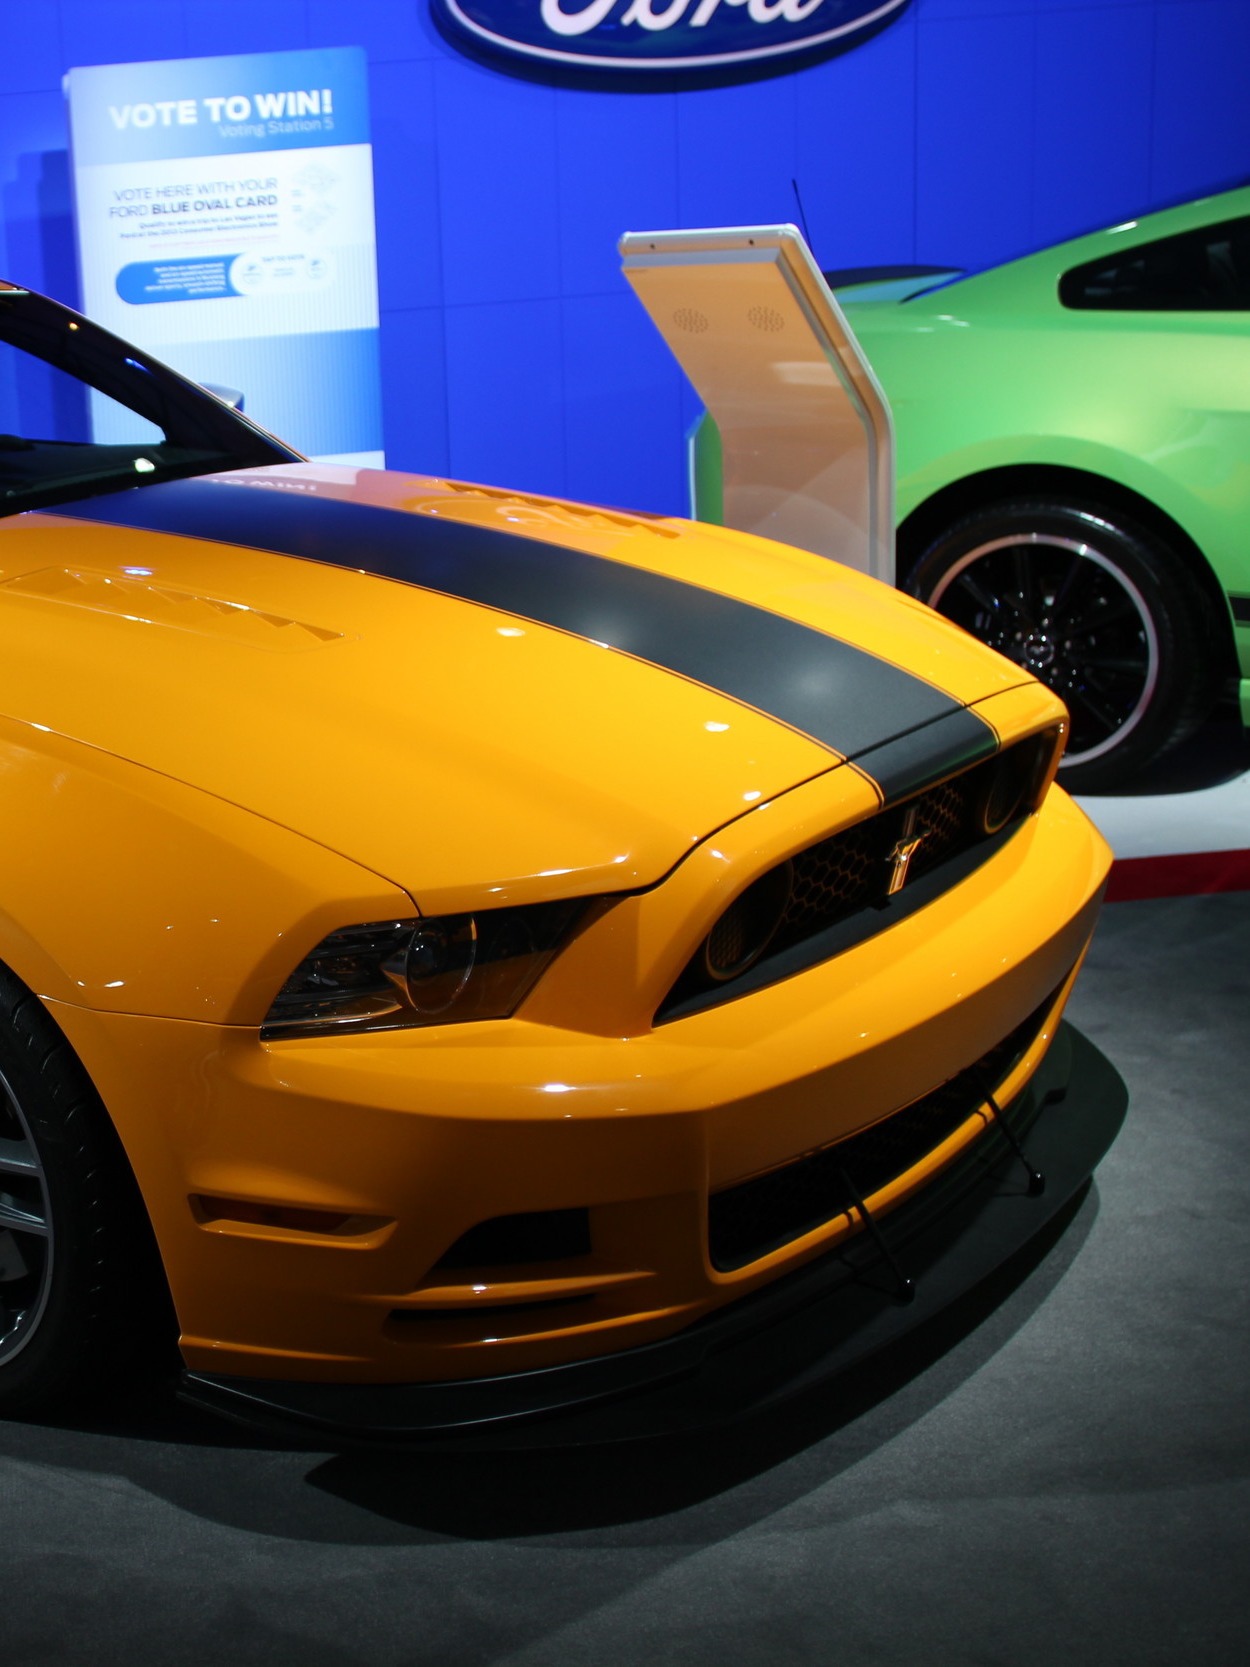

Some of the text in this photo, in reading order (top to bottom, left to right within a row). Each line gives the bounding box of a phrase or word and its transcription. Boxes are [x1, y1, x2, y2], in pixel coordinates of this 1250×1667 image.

[109, 88, 333, 130] VOTE TO WIN!
[218, 122, 266, 138] Voting
[268, 117, 321, 134] Station
[113, 177, 278, 202] VOTE HERE WITH YOUR
[109, 194, 278, 219] FORD BLUE OVAL CARD
